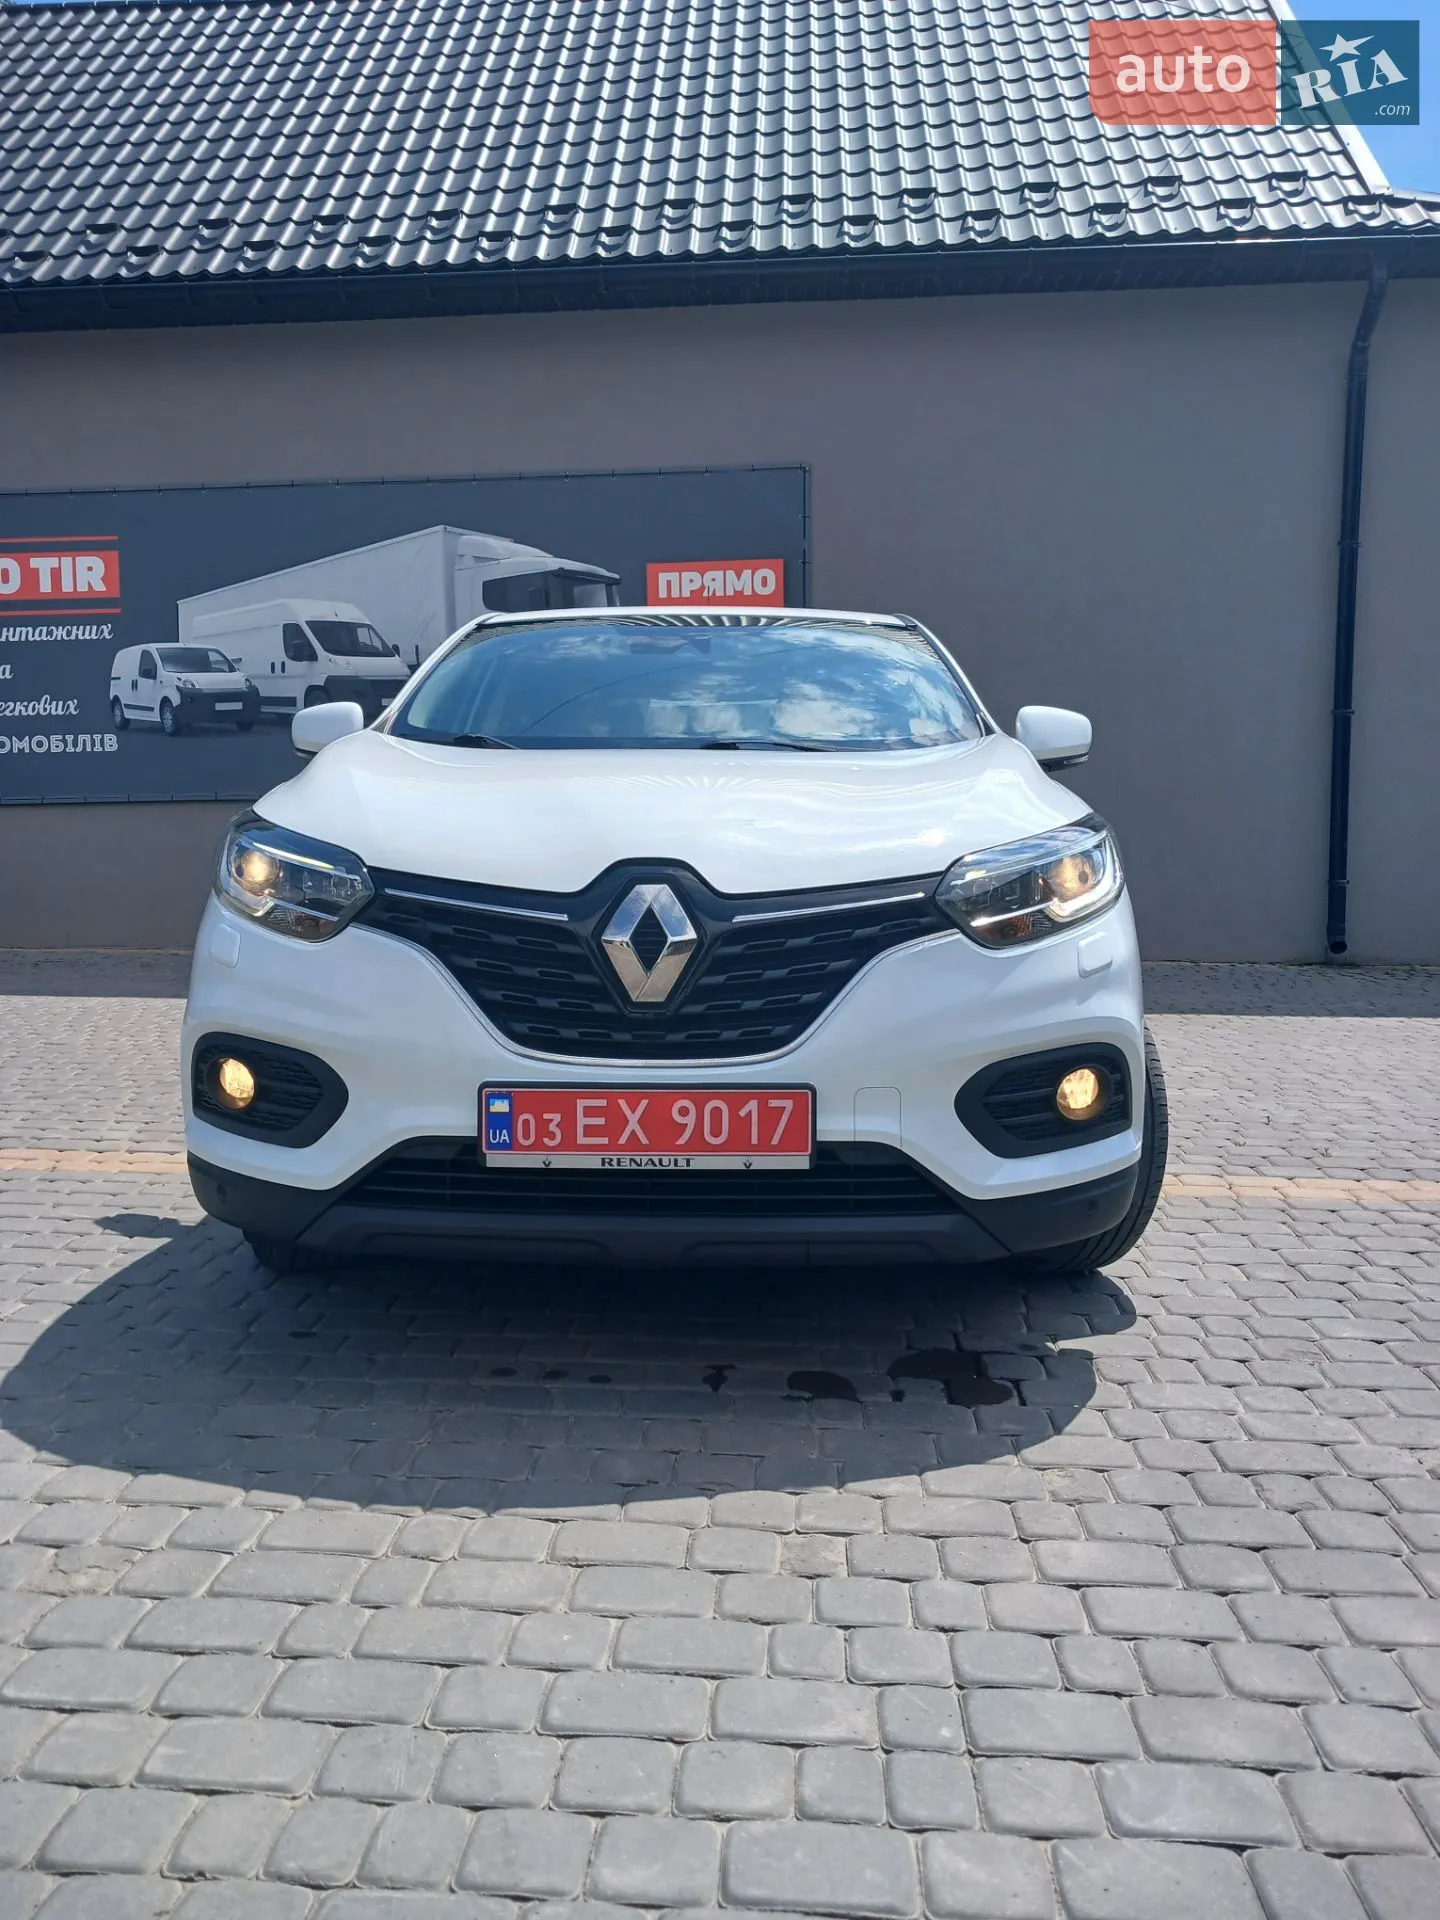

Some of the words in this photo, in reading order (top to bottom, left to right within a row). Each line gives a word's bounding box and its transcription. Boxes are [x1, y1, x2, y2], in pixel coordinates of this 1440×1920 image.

[29, 556, 107, 593] TIR
[658, 568, 776, 598] ПРЯМО
[489, 1129, 510, 1144] UA
[517, 1113, 562, 1146] 03
[576, 1099, 650, 1145] EX
[671, 1099, 795, 1145] 9017
[600, 1157, 695, 1168] RENAULT
